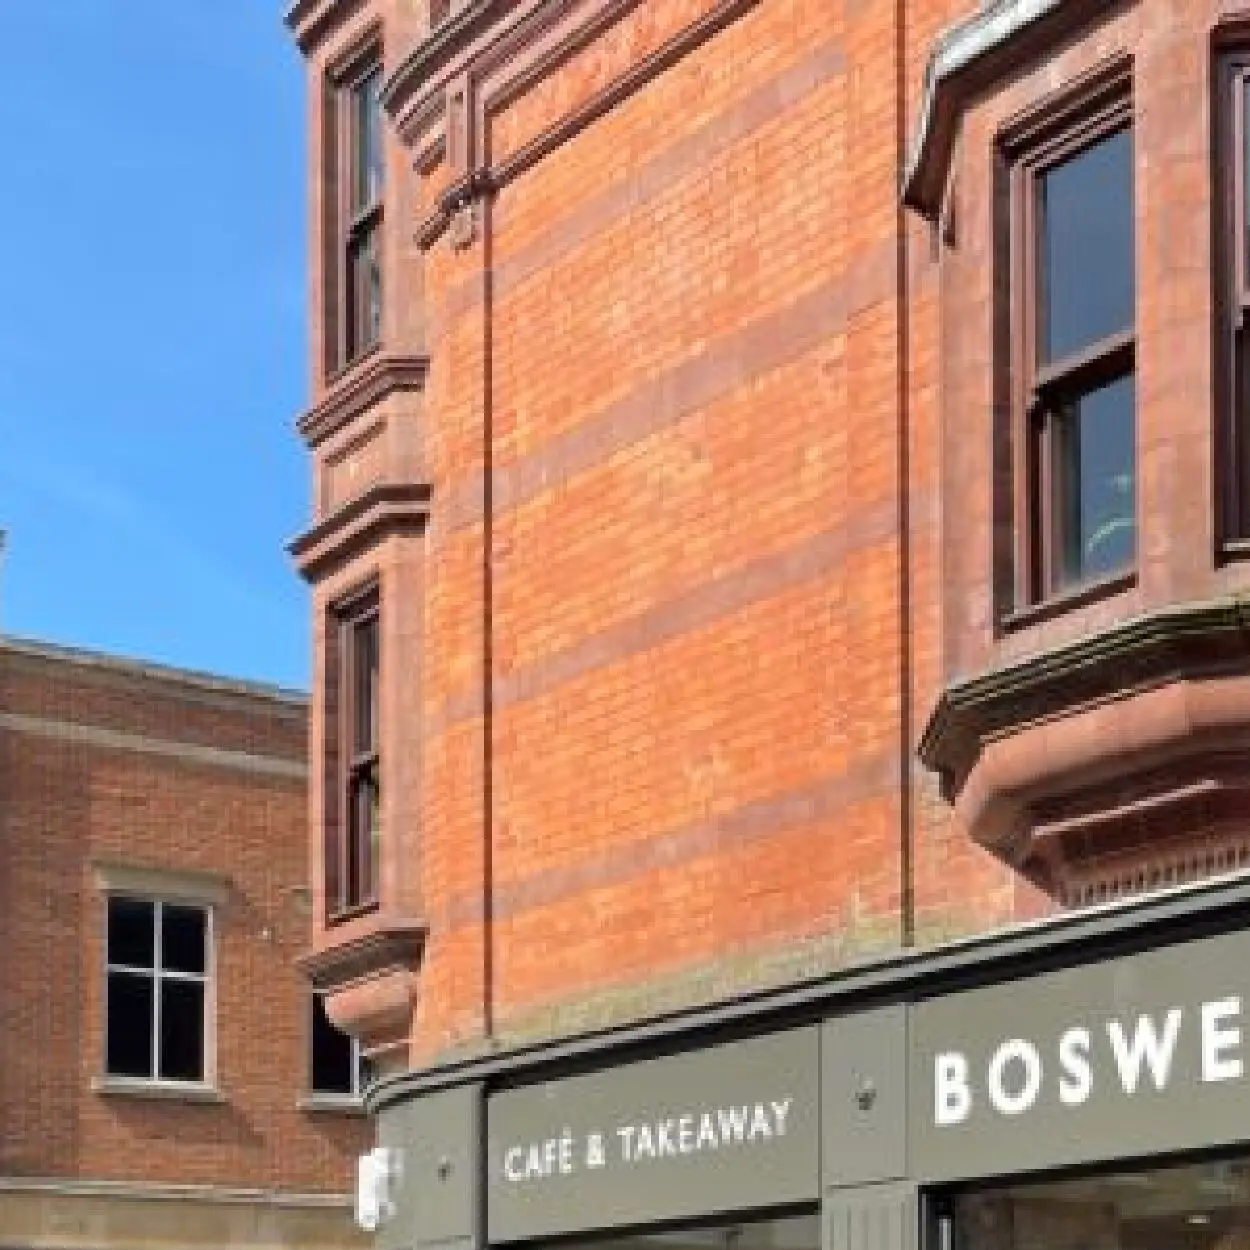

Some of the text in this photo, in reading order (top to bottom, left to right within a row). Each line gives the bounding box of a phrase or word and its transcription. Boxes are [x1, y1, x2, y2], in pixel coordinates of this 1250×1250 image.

[503, 1097, 794, 1182] CAFÉ & TAKEAWAY
